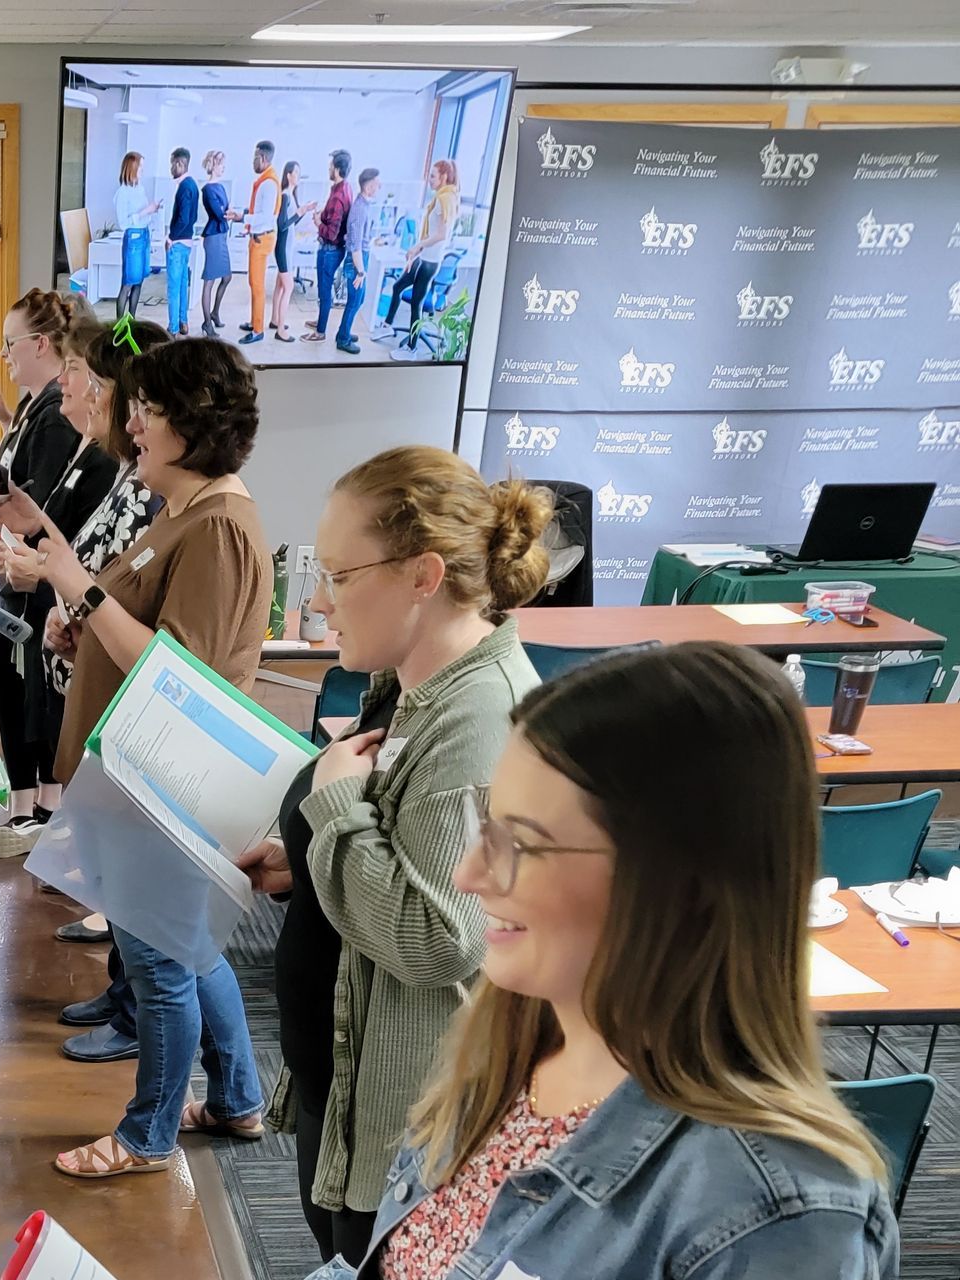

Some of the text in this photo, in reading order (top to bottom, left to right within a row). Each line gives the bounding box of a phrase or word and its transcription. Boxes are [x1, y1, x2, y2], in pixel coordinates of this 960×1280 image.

[542, 143, 597, 171] EFS
[637, 149, 718, 164] Navigating Your
[857, 152, 940, 167] Navigating Your
[633, 164, 718, 178] Financial Future.
[762, 153, 819, 179] EFS
[853, 166, 939, 180] Financial Future.
[540, 170, 589, 178] ADVISORS
[760, 179, 809, 187] ADVISORS
[519, 217, 599, 232] Navigating Your
[515, 231, 599, 246] Financial Future.
[642, 223, 698, 248] EFS
[736, 226, 816, 240] Navigating Your
[858, 222, 914, 249] EFS
[641, 248, 689, 256] ADVISORS
[732, 240, 815, 251] Financial Future.
[525, 289, 580, 315] EFS
[617, 292, 696, 308] Navigating Your
[831, 292, 908, 307] Navigating Your
[613, 307, 696, 321] Financial Future.
[738, 295, 794, 320] EFS
[826, 307, 908, 320] Financial Future.
[736, 320, 783, 328] ADVISORS
[501, 358, 579, 372] Navigating Your
[712, 364, 790, 379] Navigating Your
[829, 359, 885, 385] EFS
[498, 372, 579, 386] Financial Future.
[620, 362, 675, 387] EFS
[708, 377, 790, 389] Financial Future.
[507, 426, 560, 450] EFS
[597, 429, 673, 443] Navigating Your
[803, 425, 880, 441] Navigating Your
[592, 442, 673, 455] Financial Future.
[713, 429, 768, 454] EFS
[799, 438, 879, 453] Financial Future.
[506, 449, 551, 457] ADVISORS
[598, 494, 653, 517] EFS
[688, 494, 763, 508] Navigating Your
[684, 508, 762, 519] Financial Future.
[593, 556, 649, 568] igating Your
[593, 570, 616, 579] ncial
